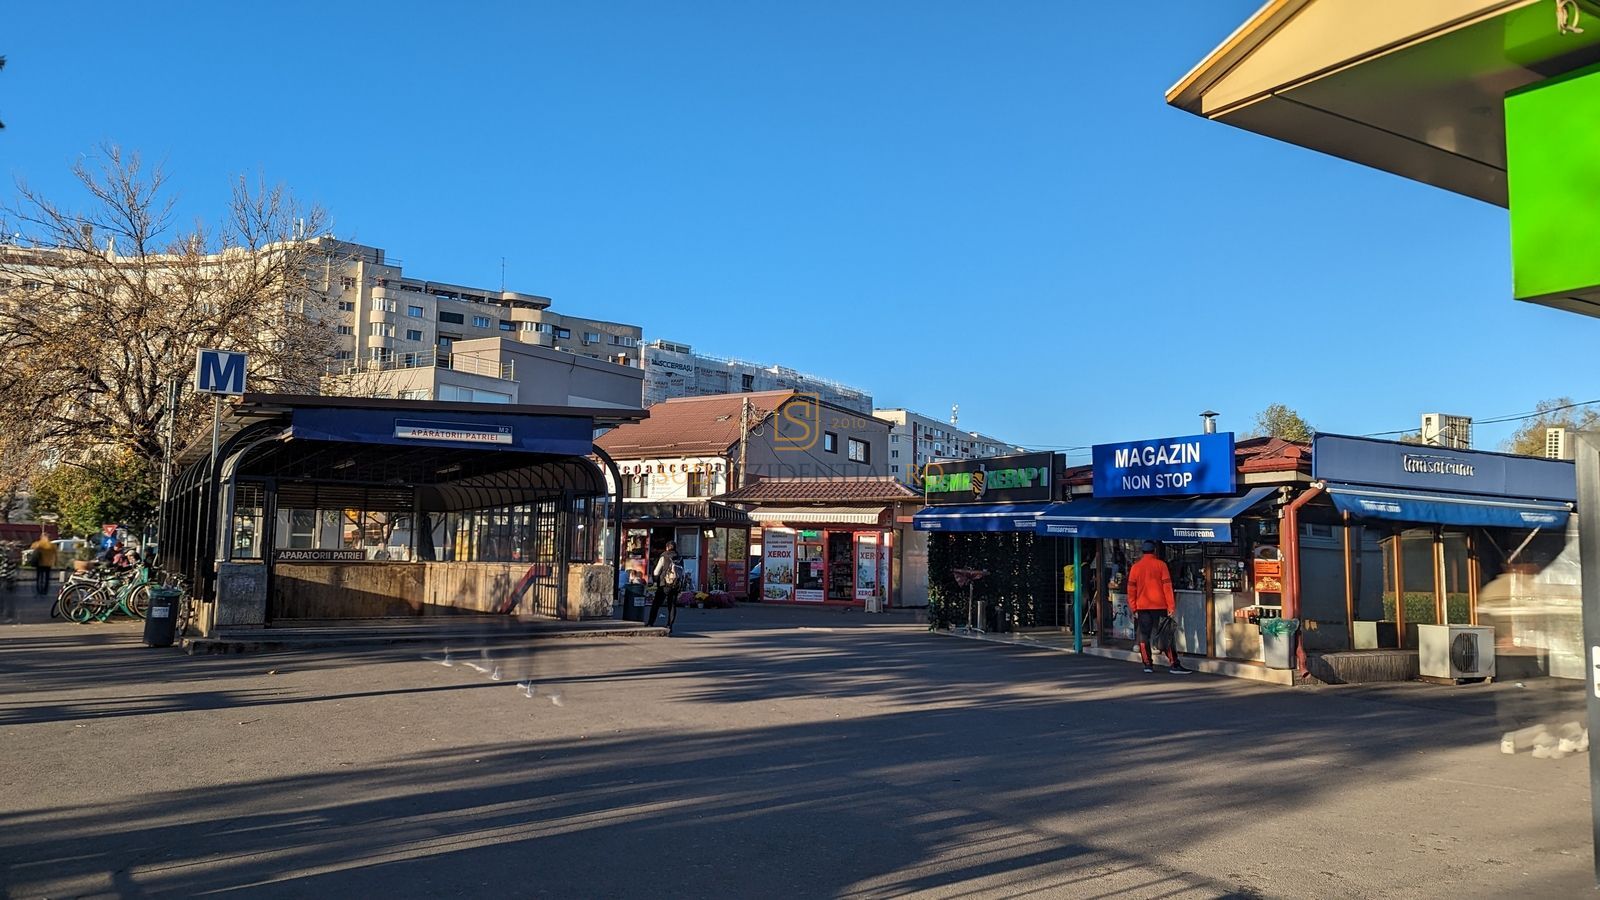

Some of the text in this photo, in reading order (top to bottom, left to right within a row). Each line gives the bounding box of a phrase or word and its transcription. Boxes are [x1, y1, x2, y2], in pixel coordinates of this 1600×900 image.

[200, 352, 245, 392] M
[465, 432, 498, 441] PATRIEI
[1115, 442, 1200, 468] MAGAZIN
[1122, 472, 1193, 490] NON STOP
[279, 551, 363, 560] APARATORII PATRIEI
[767, 550, 791, 558] XEROX
[860, 552, 885, 560] XERX
